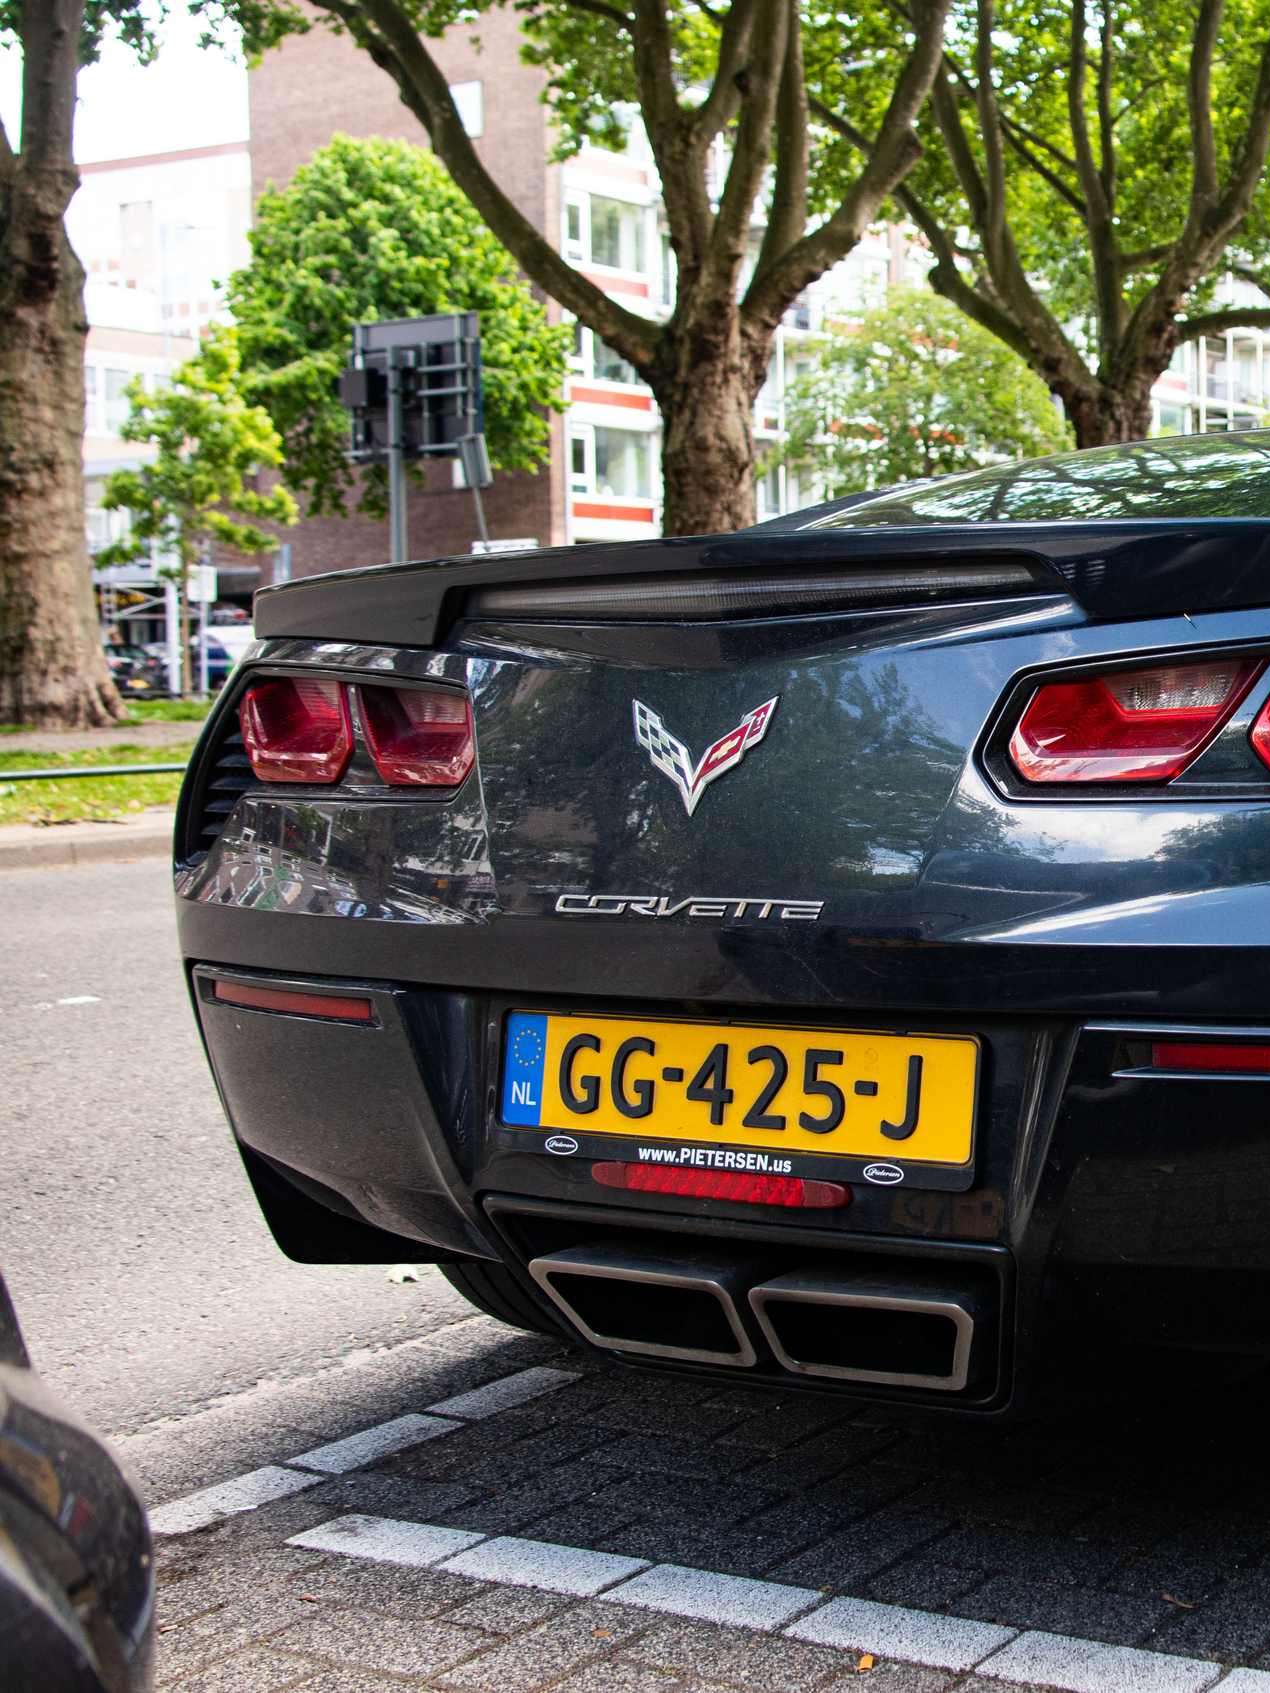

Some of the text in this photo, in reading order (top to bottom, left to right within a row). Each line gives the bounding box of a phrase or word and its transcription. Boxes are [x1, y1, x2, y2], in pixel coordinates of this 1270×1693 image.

[554, 894, 825, 920] CORVETTE
[511, 1080, 537, 1107] NL
[558, 1033, 924, 1141] GG-425-J
[638, 1147, 793, 1174] www.PIETERSEN.us
[866, 1167, 901, 1178] Pietersen
